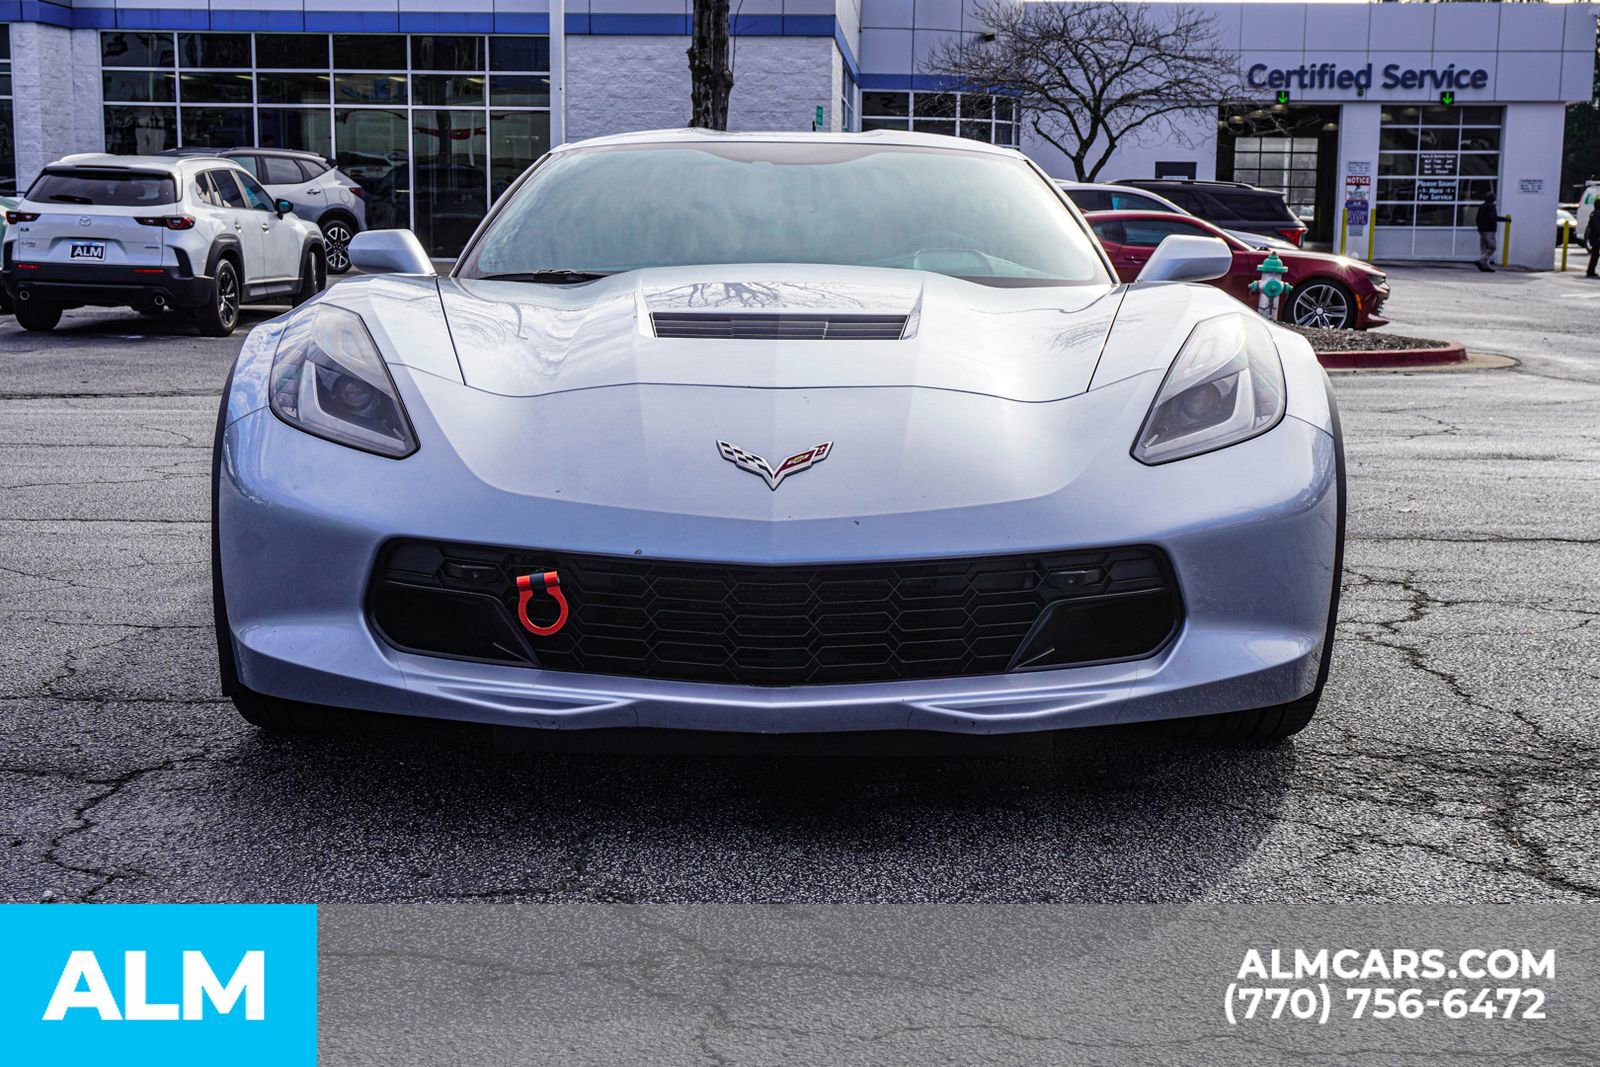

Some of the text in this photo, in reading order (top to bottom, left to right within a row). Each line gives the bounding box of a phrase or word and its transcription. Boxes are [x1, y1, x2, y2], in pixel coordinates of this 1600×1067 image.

[1247, 63, 1489, 90] Certified Service
[1347, 176, 1370, 184] NOTICE
[73, 246, 103, 257] ALM
